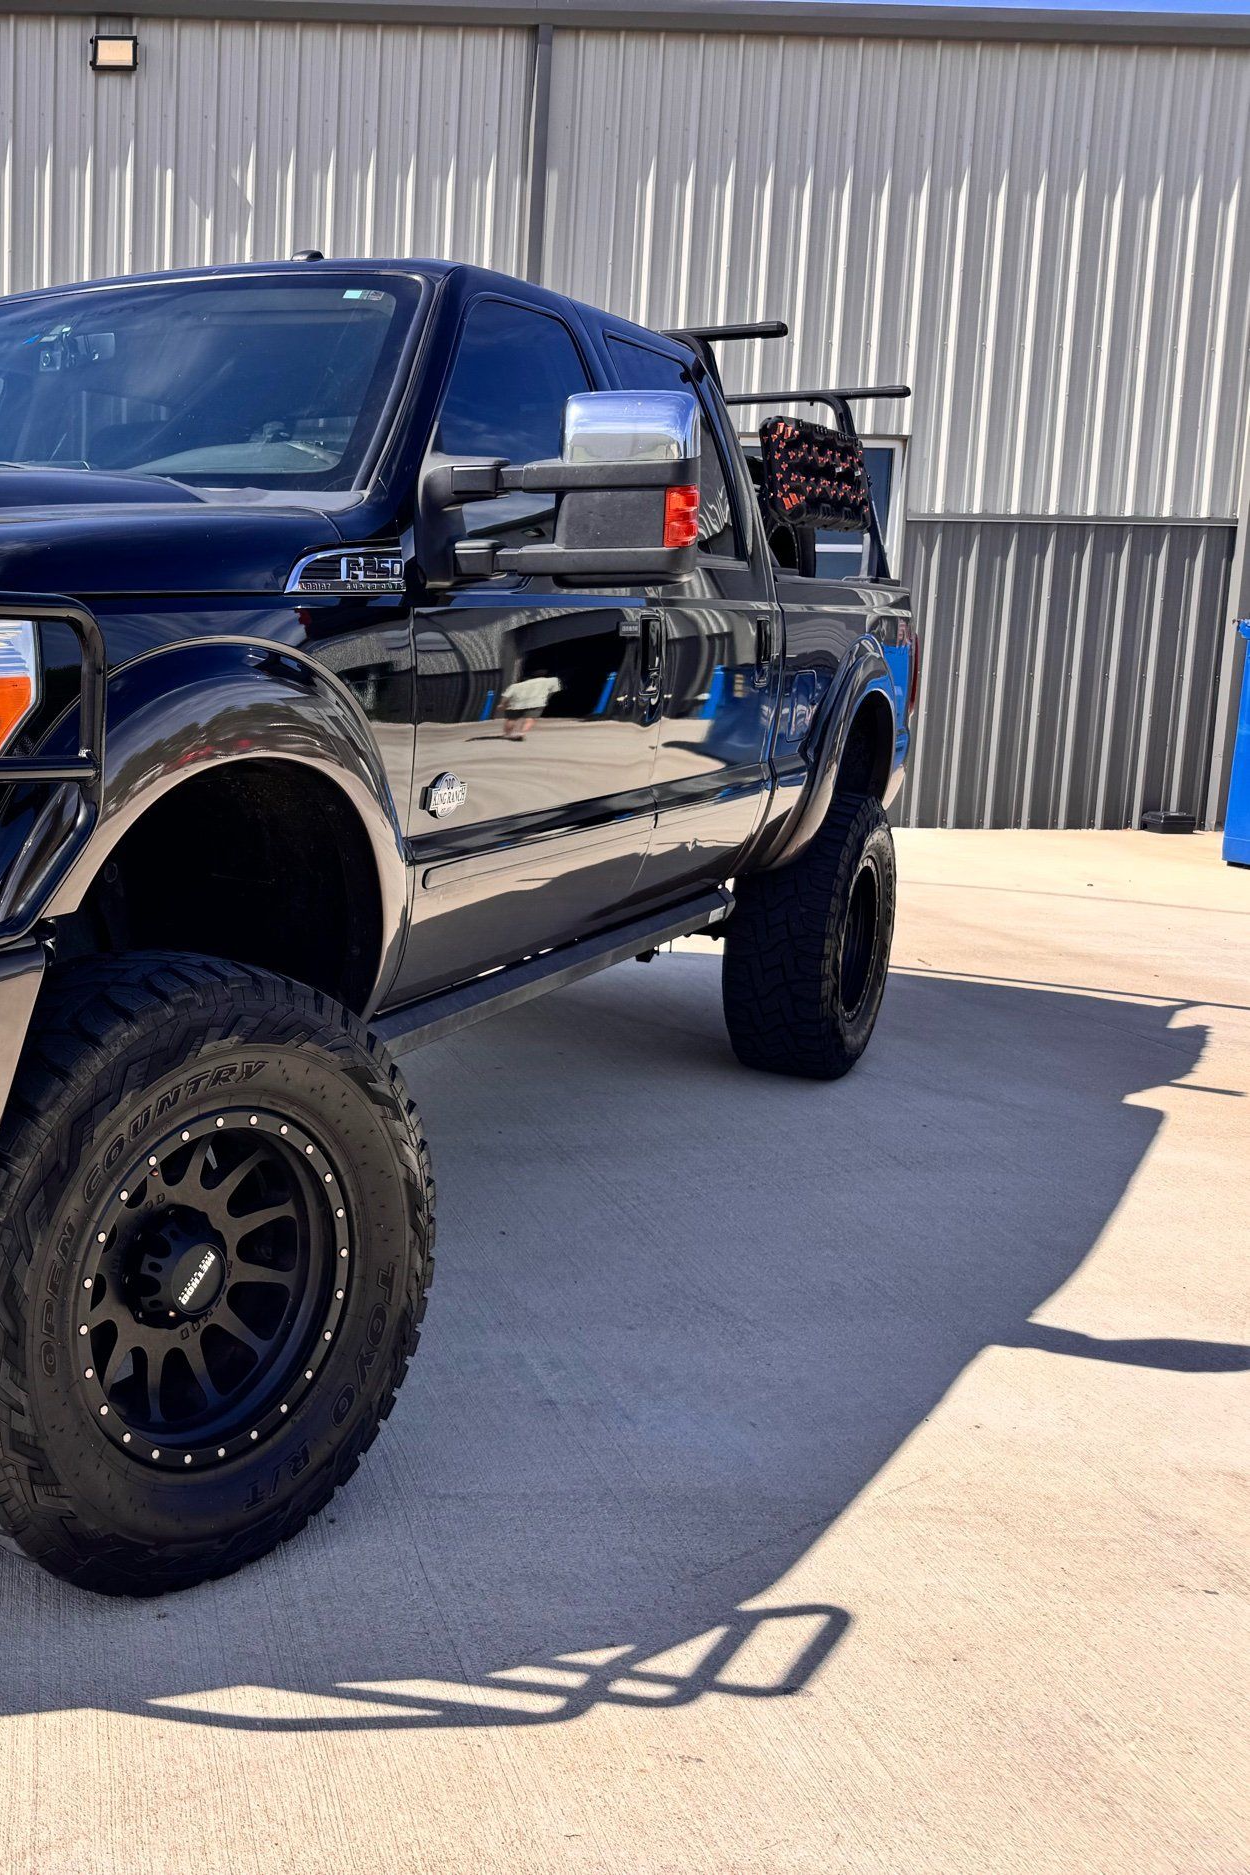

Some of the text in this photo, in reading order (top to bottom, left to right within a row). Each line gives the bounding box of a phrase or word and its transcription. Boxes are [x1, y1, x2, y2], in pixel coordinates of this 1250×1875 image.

[432, 786, 466, 806] KING RANCH
[41, 1215, 77, 1377] OPEN
[83, 1060, 269, 1203] COUNTRY
[331, 1261, 397, 1428] TOYO
